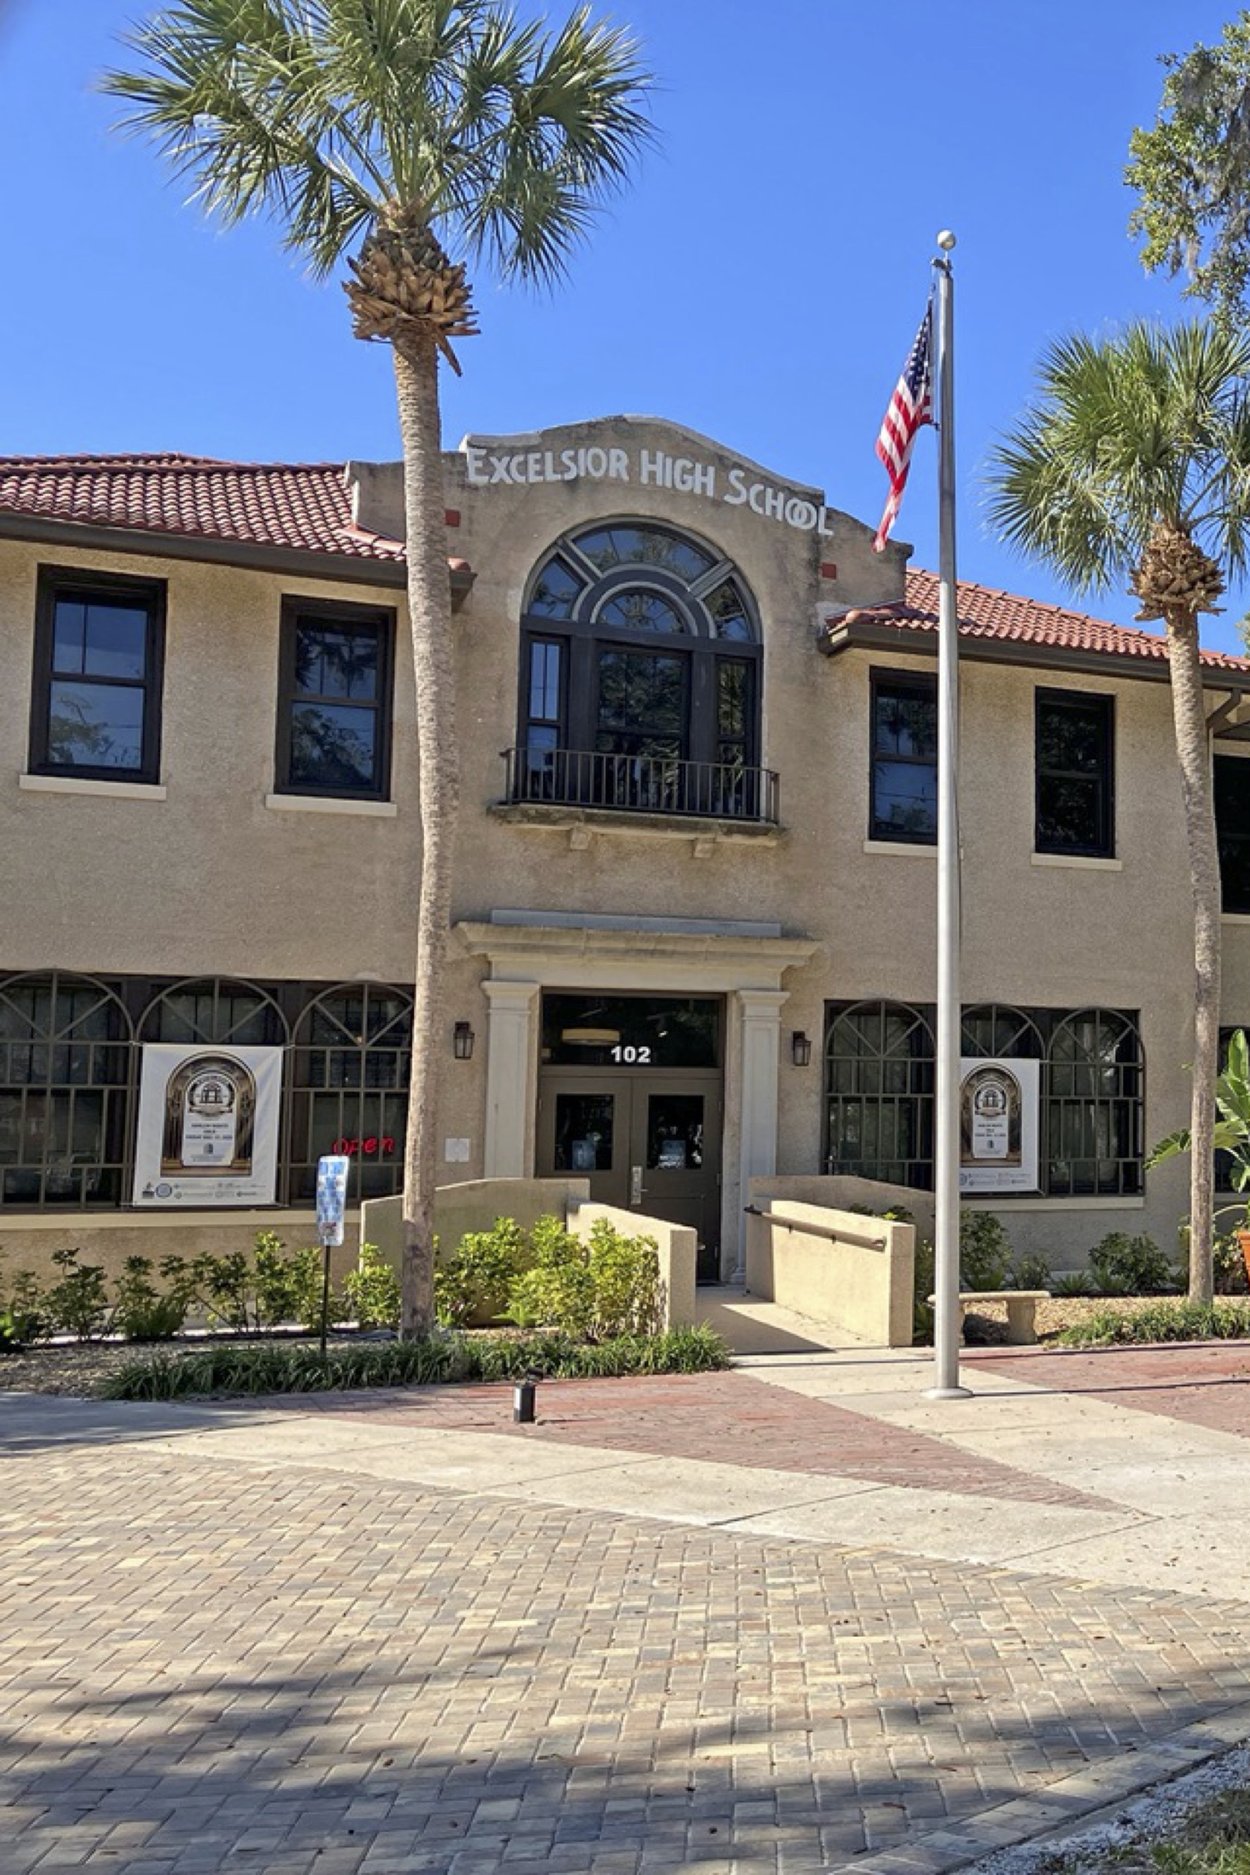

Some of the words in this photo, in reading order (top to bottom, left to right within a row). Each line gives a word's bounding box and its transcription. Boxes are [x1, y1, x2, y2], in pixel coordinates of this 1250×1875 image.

[467, 447, 630, 485] EXCELSIOR
[640, 449, 715, 497] HIGH
[724, 469, 834, 536] SCHOOL
[611, 1046, 651, 1063] 102
